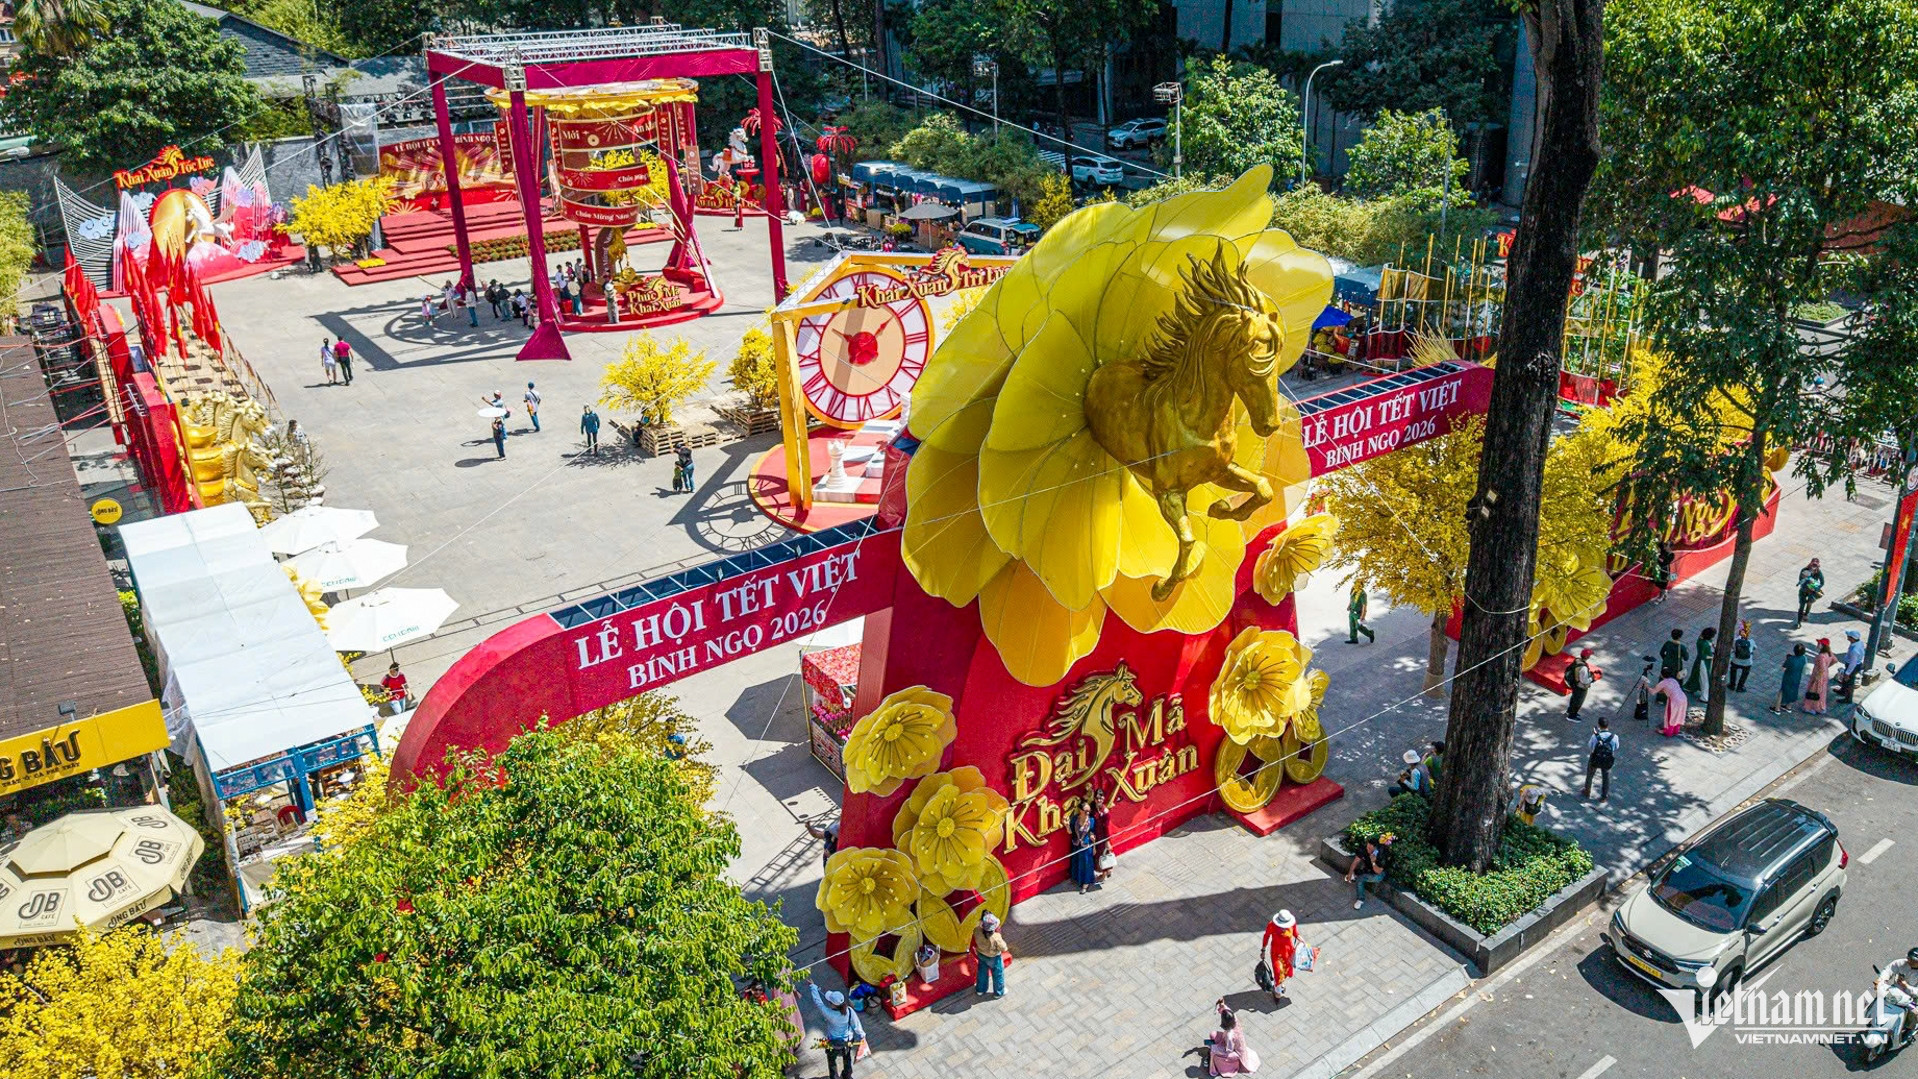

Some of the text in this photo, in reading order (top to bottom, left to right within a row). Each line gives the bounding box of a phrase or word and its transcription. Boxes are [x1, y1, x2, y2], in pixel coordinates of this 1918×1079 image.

[116, 171, 145, 189] Khai
[629, 303, 656, 316] Khai
[857, 283, 901, 308] Khai
[1303, 379, 1462, 449] LỄ HỘI TẾT VIỆT
[1325, 415, 1436, 469] BÍNH NGỌ 2026
[575, 550, 861, 670] LỄ HỘI TẾT VIỆT
[628, 600, 827, 689] BÍNH NGỌ 2026
[1011, 693, 1187, 806] Đại Mã
[1105, 744, 1199, 808] Xuân
